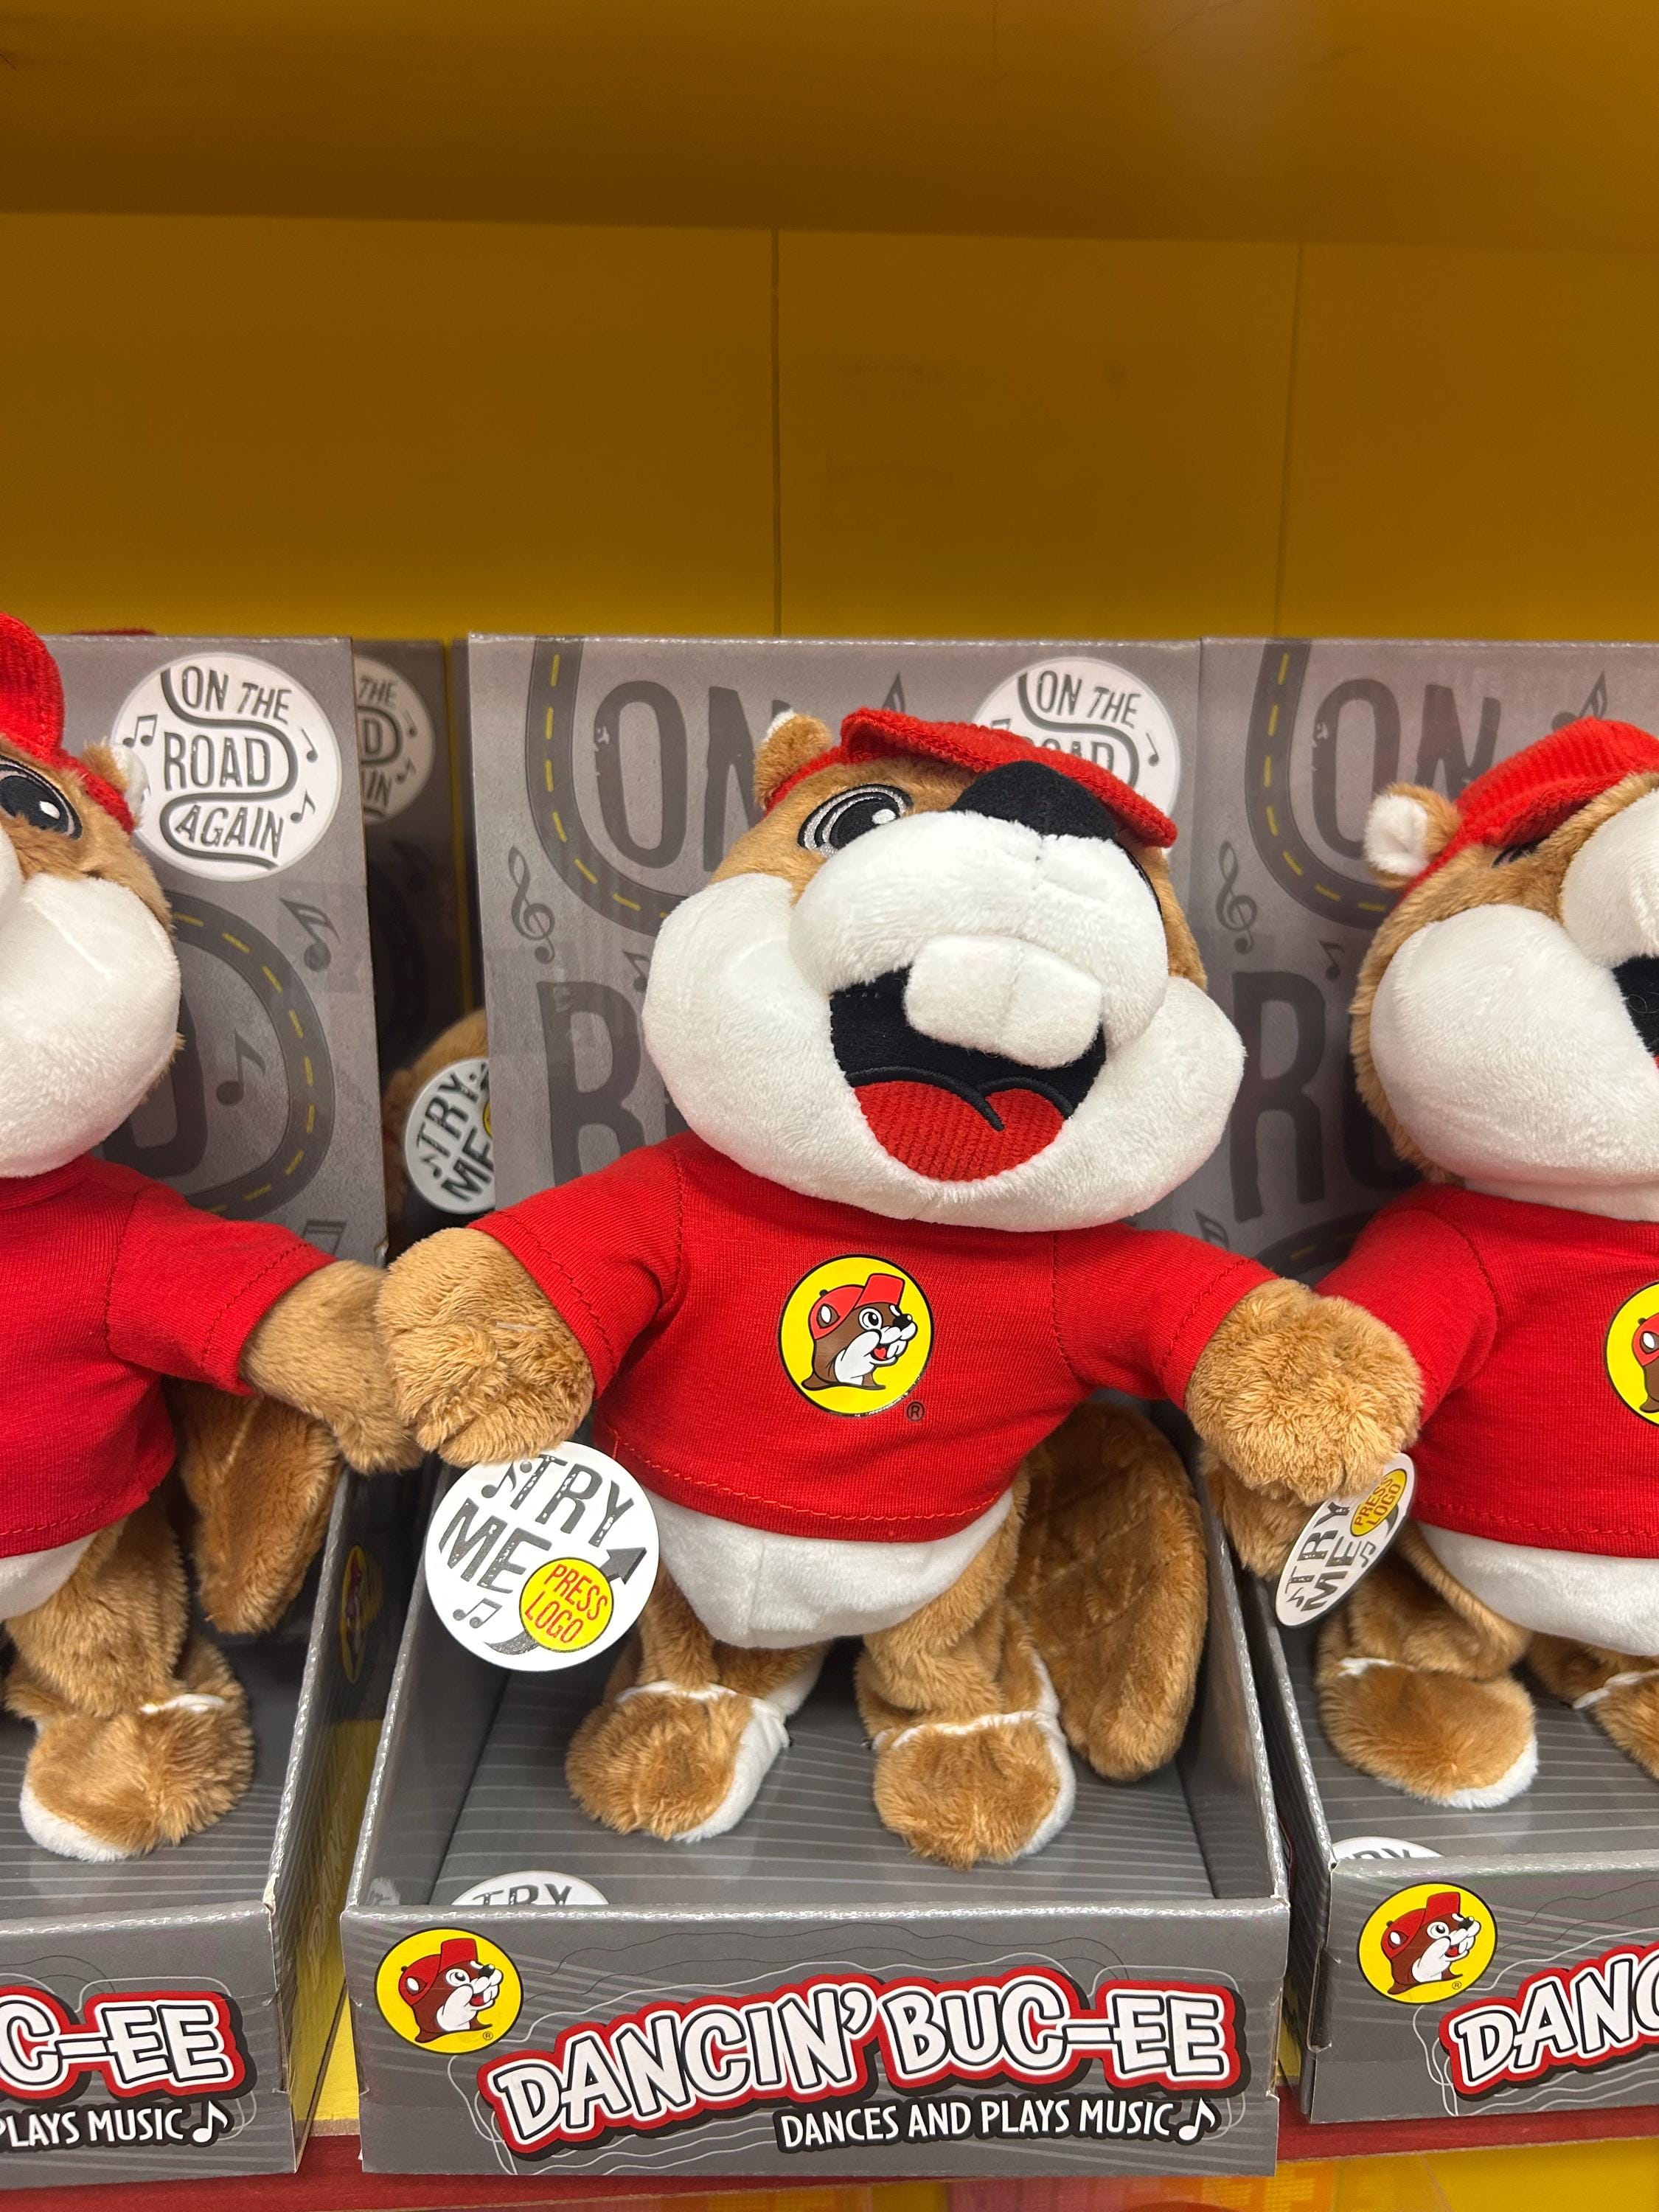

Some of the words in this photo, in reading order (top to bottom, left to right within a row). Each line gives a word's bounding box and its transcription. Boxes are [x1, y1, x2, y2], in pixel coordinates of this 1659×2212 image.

[182, 666, 229, 711] ON
[236, 681, 292, 724] THE
[1037, 670, 1082, 715] ON
[1087, 686, 1142, 728] THE
[164, 731, 271, 790] ROAD
[175, 803, 284, 858] AGAIN
[417, 1072, 479, 1158] TRY
[510, 1454, 634, 1548] TRY
[1366, 1483, 1401, 1526] LOGO
[438, 1498, 552, 1593] ME
[1285, 1502, 1350, 1593] TRY
[1301, 1535, 1362, 1612] ME
[524, 1590, 583, 1644] LOGO
[544, 1563, 608, 1621] PRESS
[487, 1982, 877, 2140] DANCIN'
[880, 1975, 1230, 2081] BUC-EE
[88, 2108, 184, 2142] MUSIC
[782, 2105, 899, 2148] DANCES
[908, 2102, 971, 2138] AND
[981, 2099, 1070, 2134] PLAYS
[1079, 2100, 1174, 2135] MUSIC
